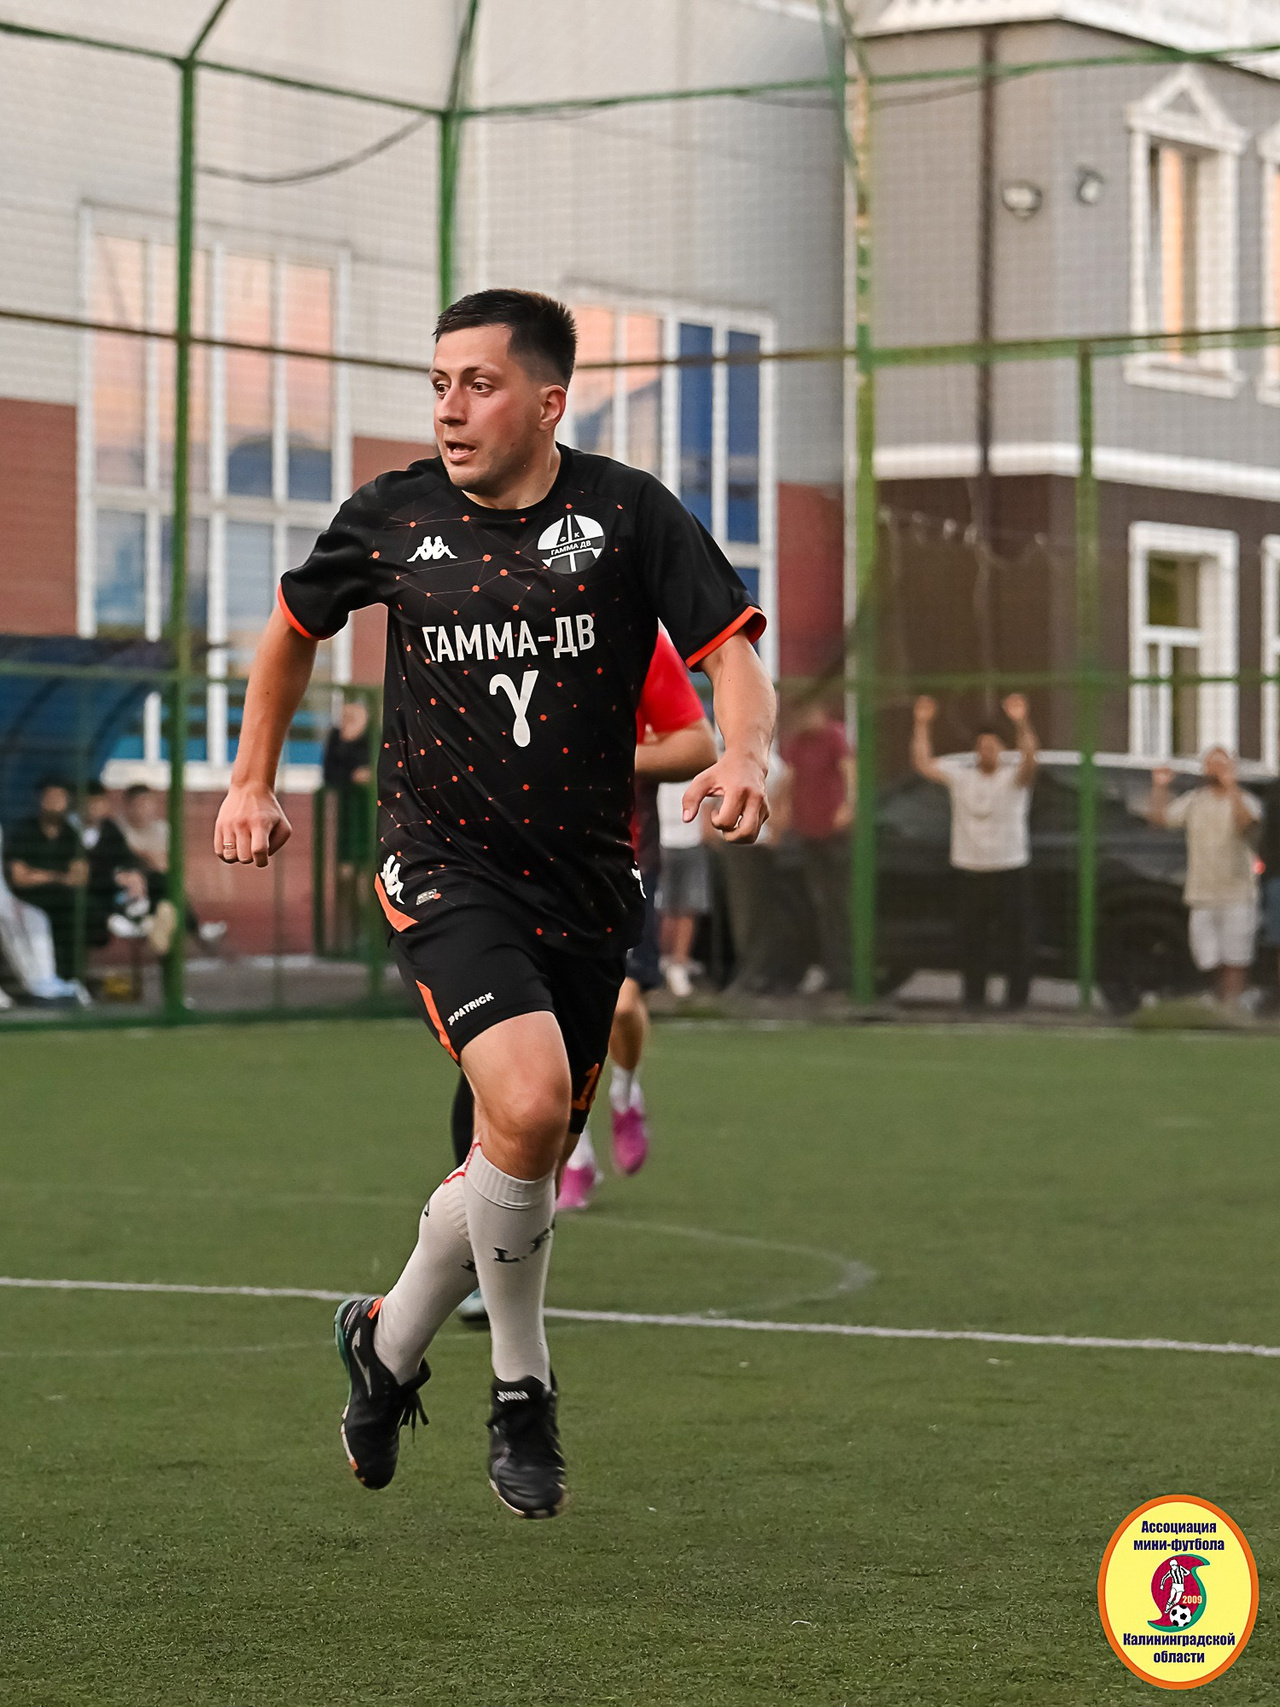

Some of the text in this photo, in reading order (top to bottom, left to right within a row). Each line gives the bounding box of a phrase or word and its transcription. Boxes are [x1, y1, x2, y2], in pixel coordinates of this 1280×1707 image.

[550, 540, 592, 556] ГАММА ДВ
[421, 613, 596, 663] ГАММА-ДВ
[453, 991, 495, 1021] PATRICK
